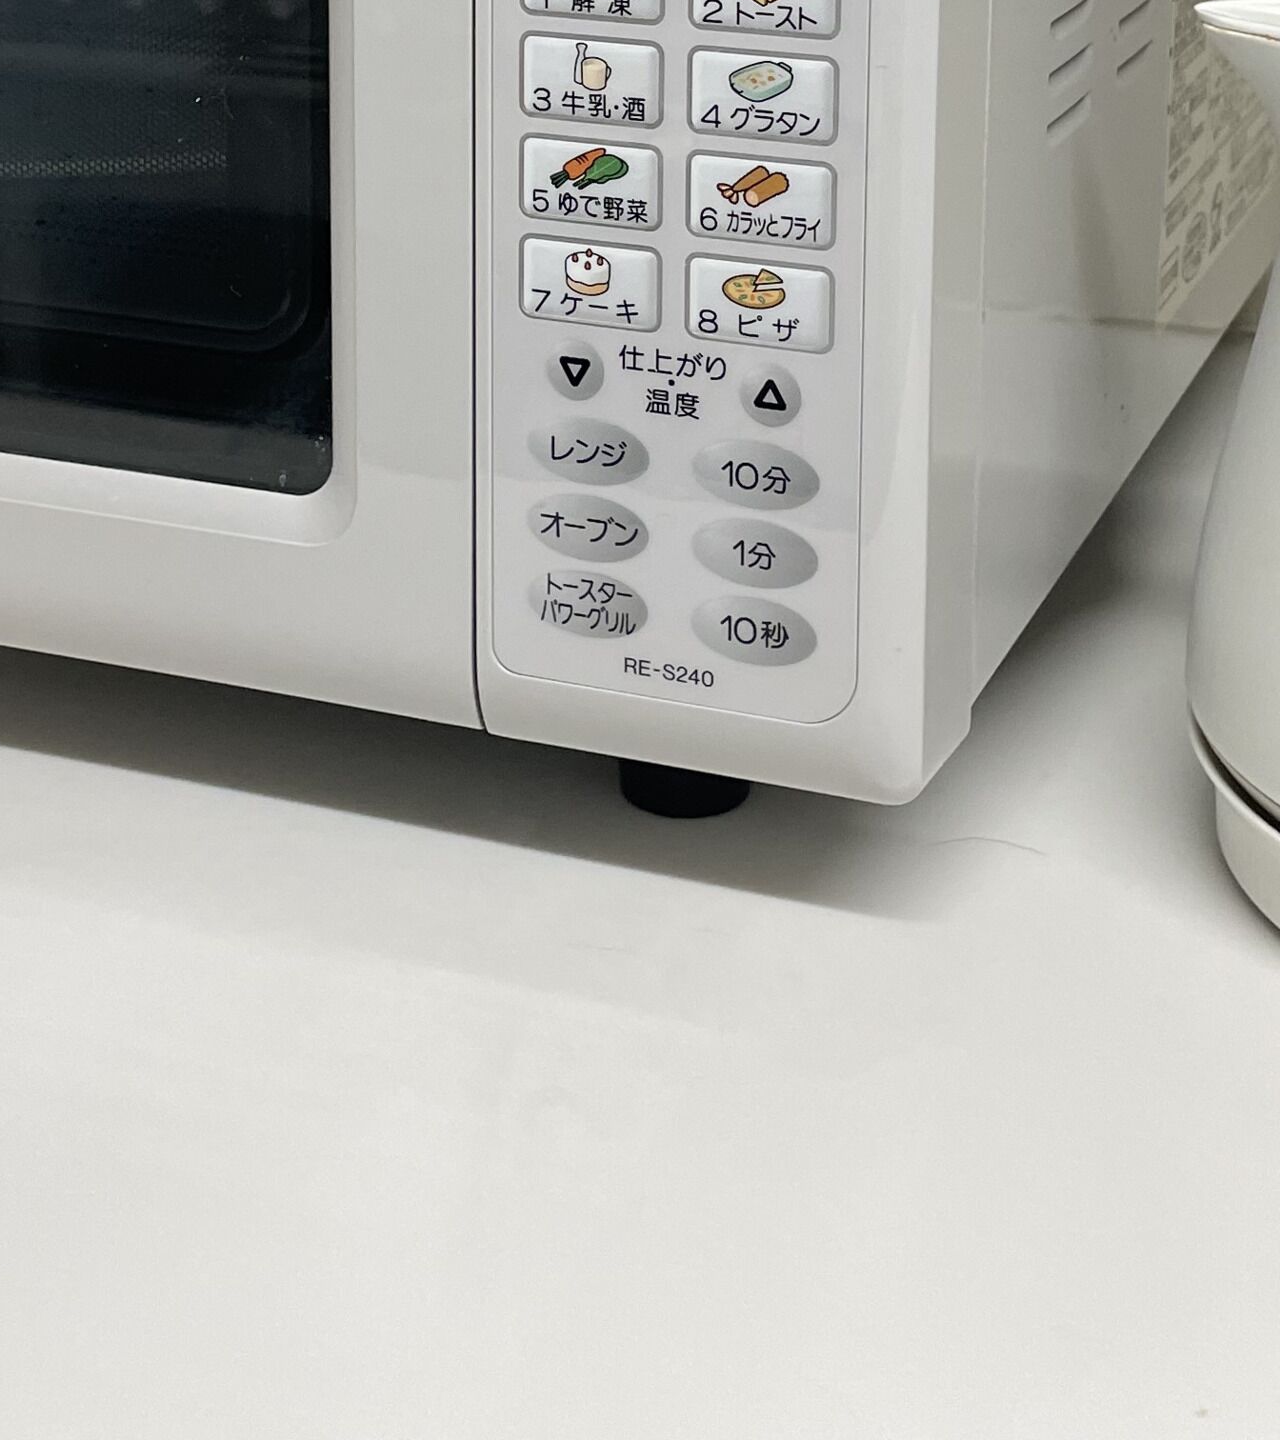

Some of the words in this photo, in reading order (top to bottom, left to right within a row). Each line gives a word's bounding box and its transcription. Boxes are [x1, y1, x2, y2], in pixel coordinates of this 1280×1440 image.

[736, 5, 817, 31] トースト
[730, 105, 820, 136] グラタン
[558, 193, 648, 223] ゆで野菜
[727, 210, 821, 242] カラッとフライ
[560, 293, 639, 324] ケーキ
[550, 435, 627, 467] レンジ
[540, 512, 638, 546] オーブン
[547, 573, 632, 604] トースター
[541, 599, 636, 635] パワーグリル
[624, 657, 714, 687] RE-S240
